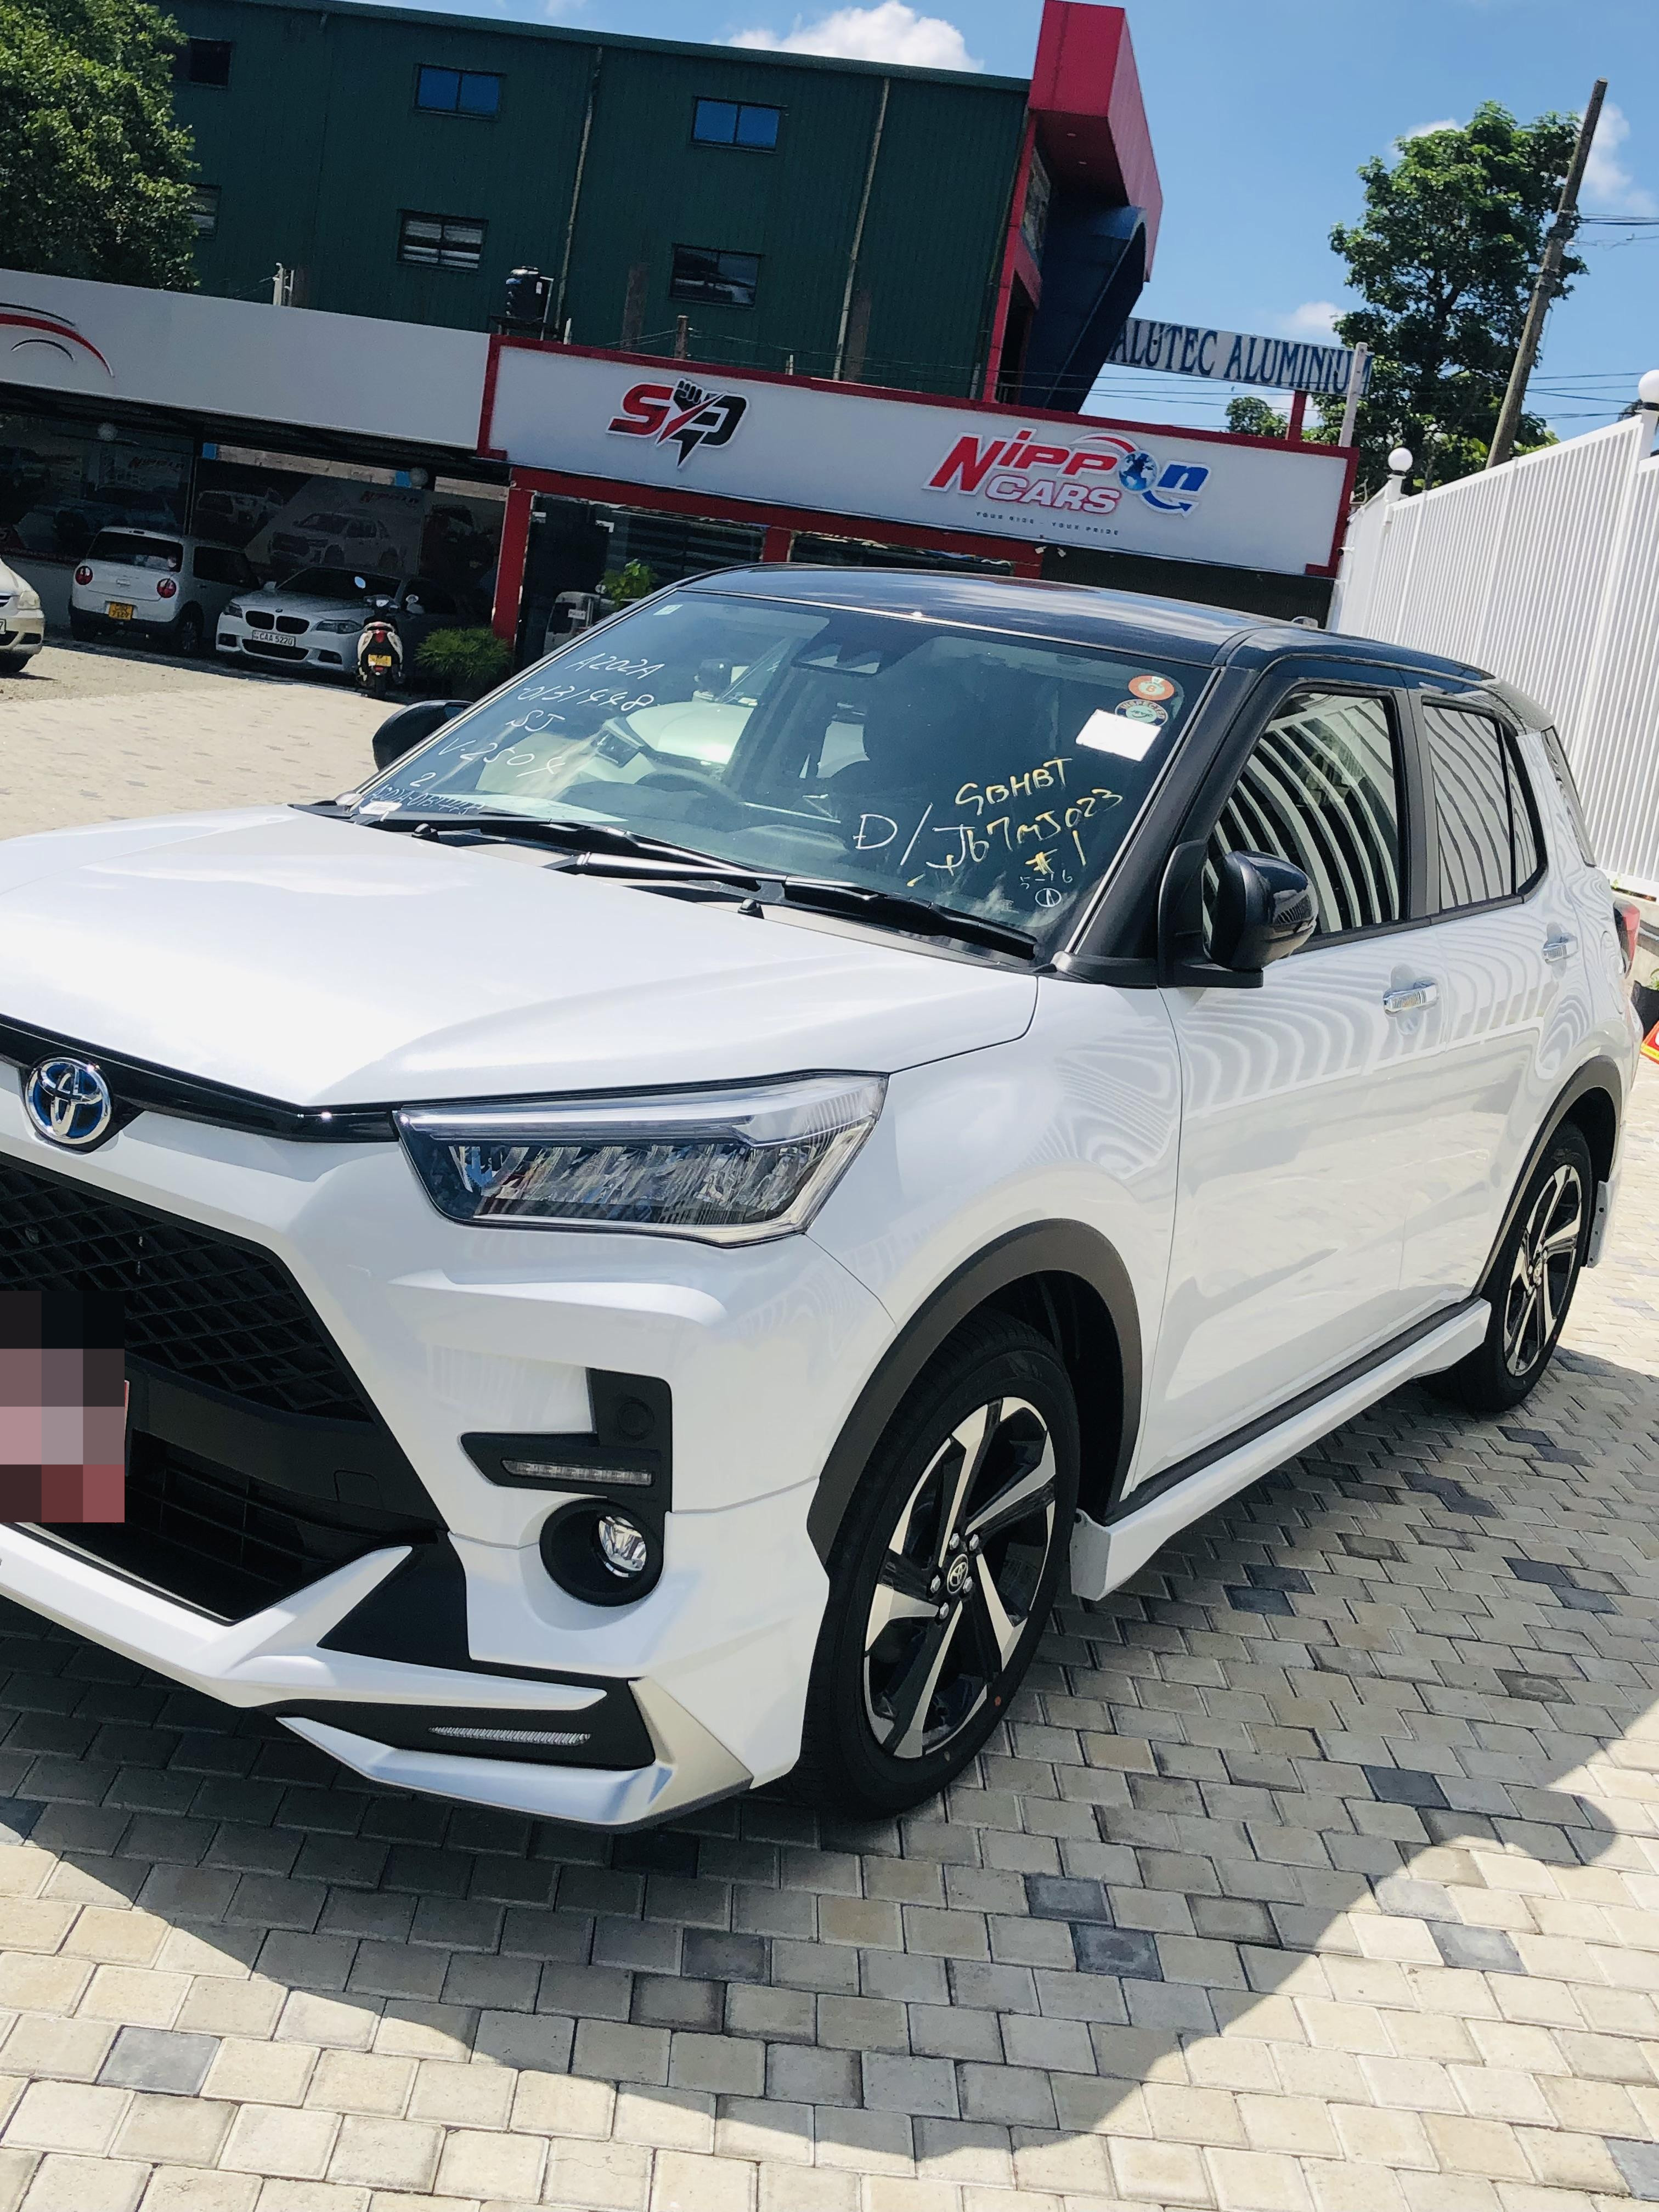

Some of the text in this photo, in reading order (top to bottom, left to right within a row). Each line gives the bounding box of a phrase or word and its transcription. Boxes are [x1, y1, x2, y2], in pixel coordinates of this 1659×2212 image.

[986, 474, 1122, 514] CARS
[975, 511, 1003, 520] YOUR
[1051, 522, 1080, 531] YOUR
[1085, 526, 1119, 536] PRIDE
[259, 633, 273, 641] CAA
